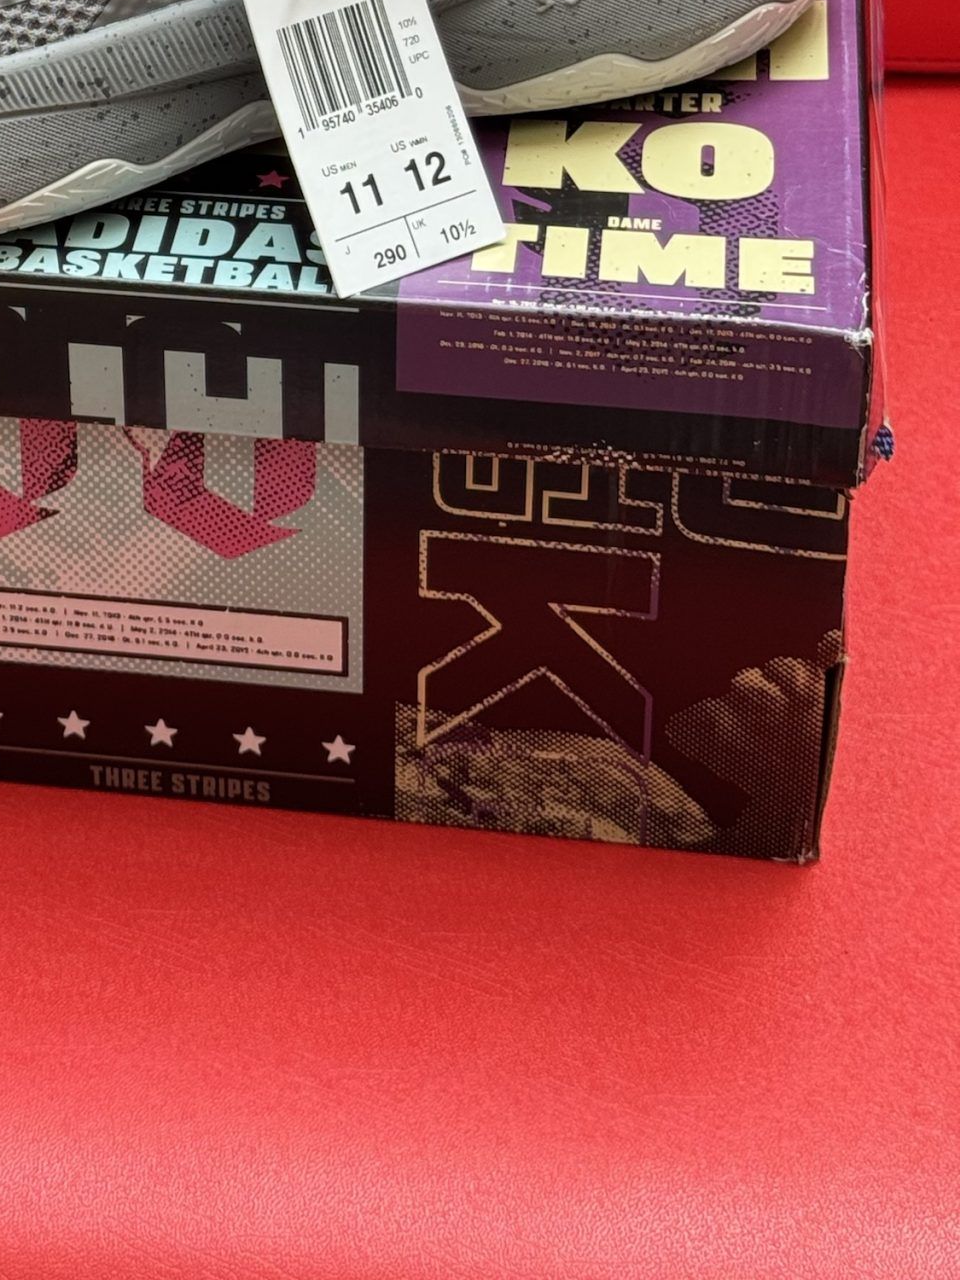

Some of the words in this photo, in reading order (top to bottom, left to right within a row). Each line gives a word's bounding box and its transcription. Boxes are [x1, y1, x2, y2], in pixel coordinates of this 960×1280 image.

[403, 35, 420, 47] 720
[409, 50, 430, 64] UPC
[297, 126, 307, 140] 1
[322, 109, 357, 132] 95740
[366, 96, 400, 118] 35406
[415, 86, 424, 99] 0
[390, 140, 407, 154] US
[409, 135, 428, 148] WMN
[322, 163, 339, 179] US
[340, 160, 357, 173] MEN
[403, 150, 452, 193] 12
[501, 120, 775, 201] KO
[339, 172, 385, 215] 11
[179, 199, 287, 219] STRIPES
[412, 217, 427, 231] UK
[607, 216, 663, 231] DAME
[373, 245, 408, 270] 290
[470, 222, 816, 295] TIME
[90, 765, 163, 792] THREE
[171, 772, 271, 803] STRIPES
